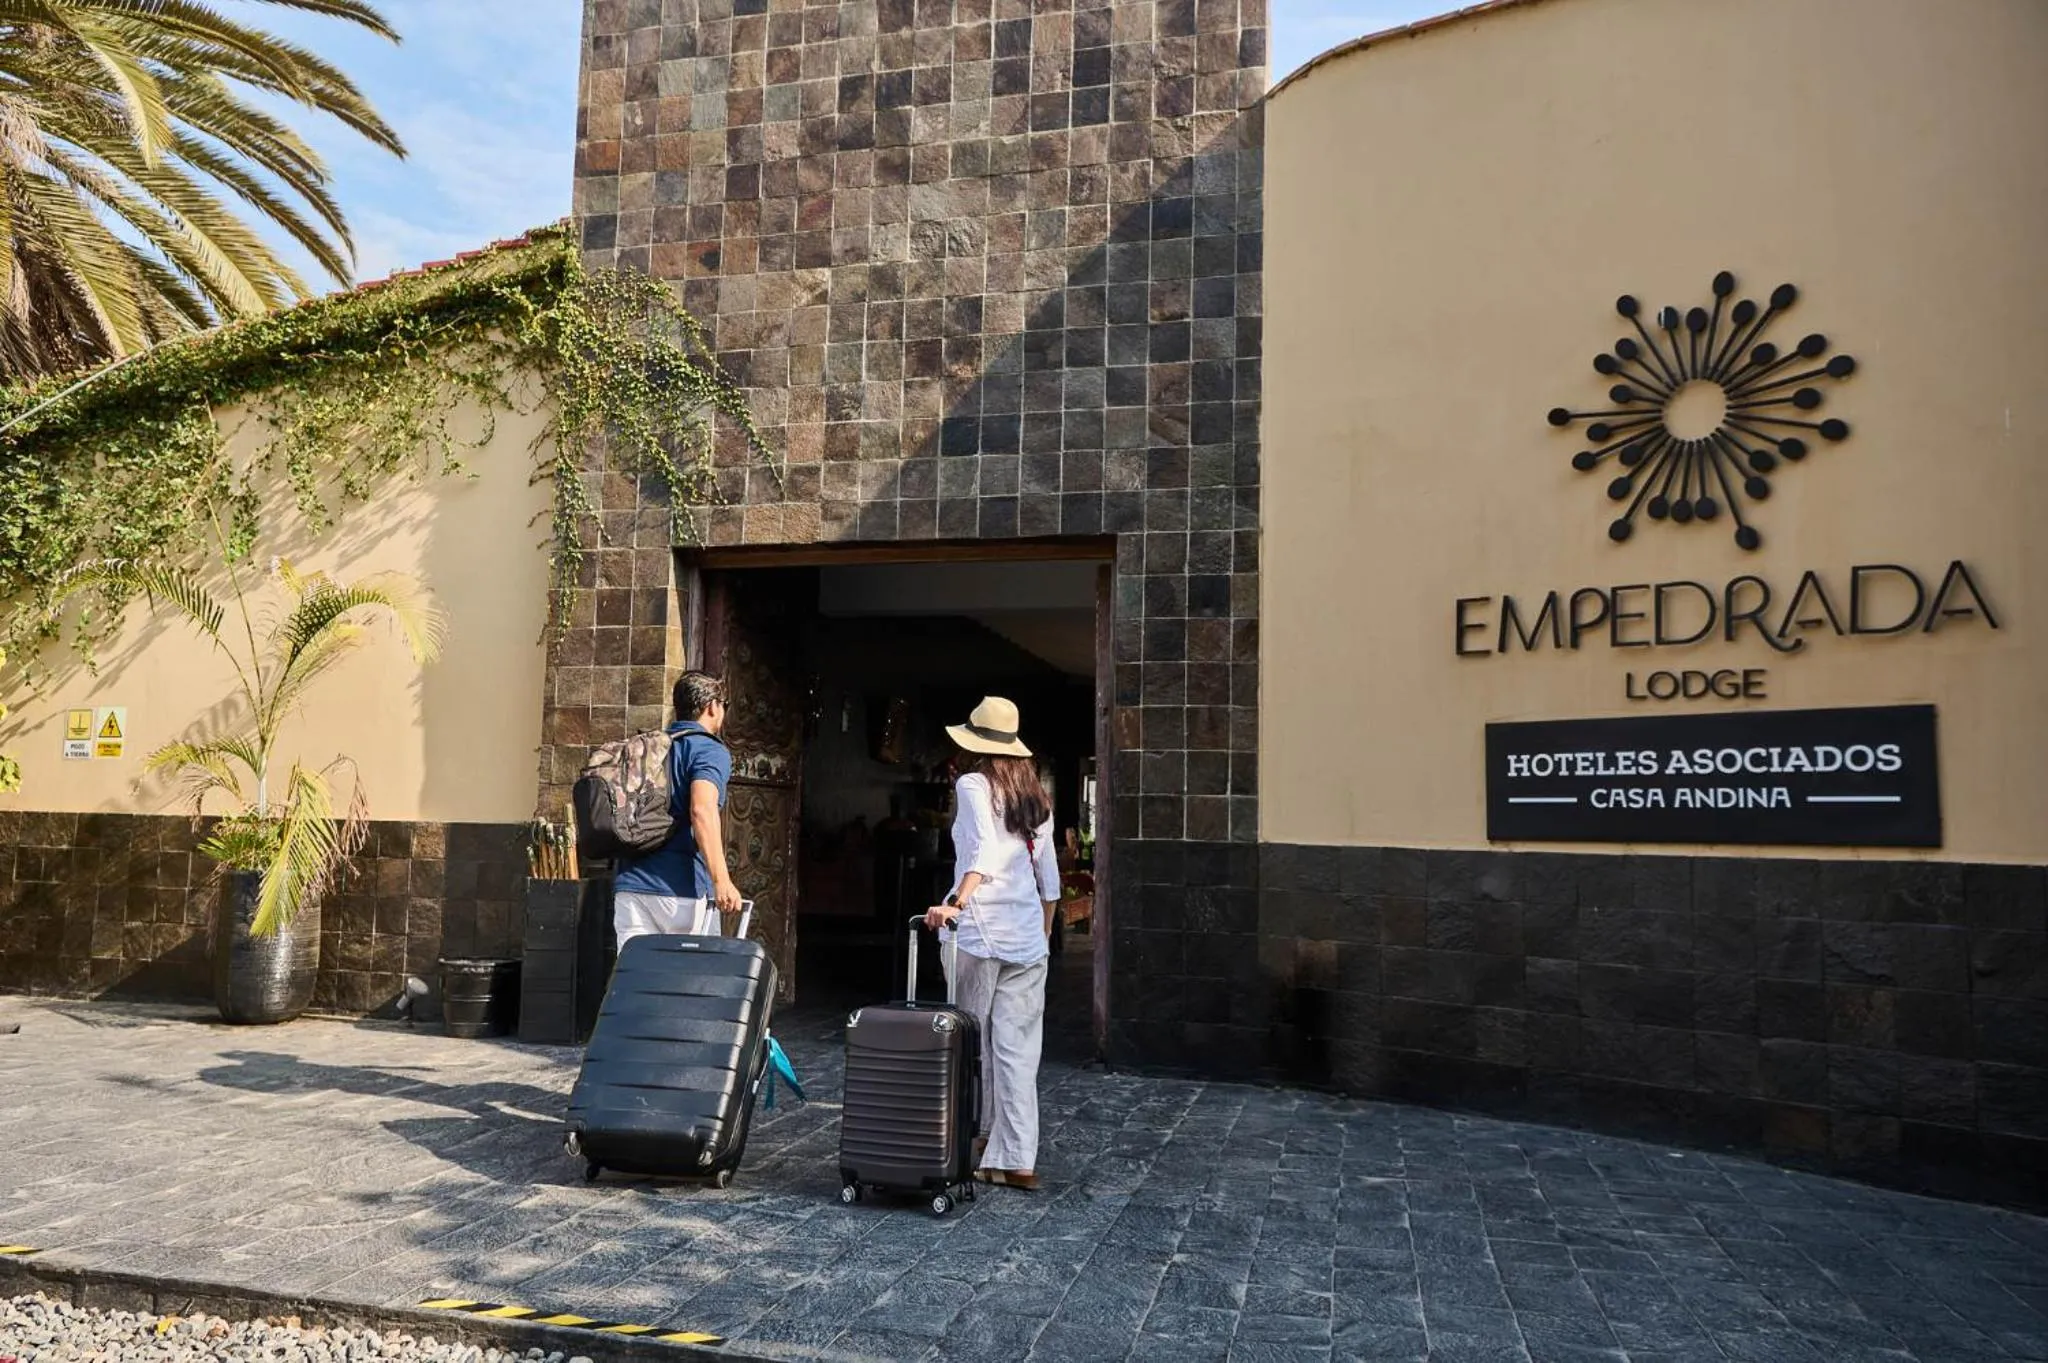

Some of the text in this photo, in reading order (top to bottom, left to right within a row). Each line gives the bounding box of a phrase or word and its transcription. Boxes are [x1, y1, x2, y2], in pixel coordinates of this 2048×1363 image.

[1456, 560, 1998, 656] EMPEDRADA
[1626, 669, 1767, 700] LODGE
[1507, 744, 1902, 777] HOTELES ASOCIADOS
[1590, 787, 1792, 808] CASA ANDINA
